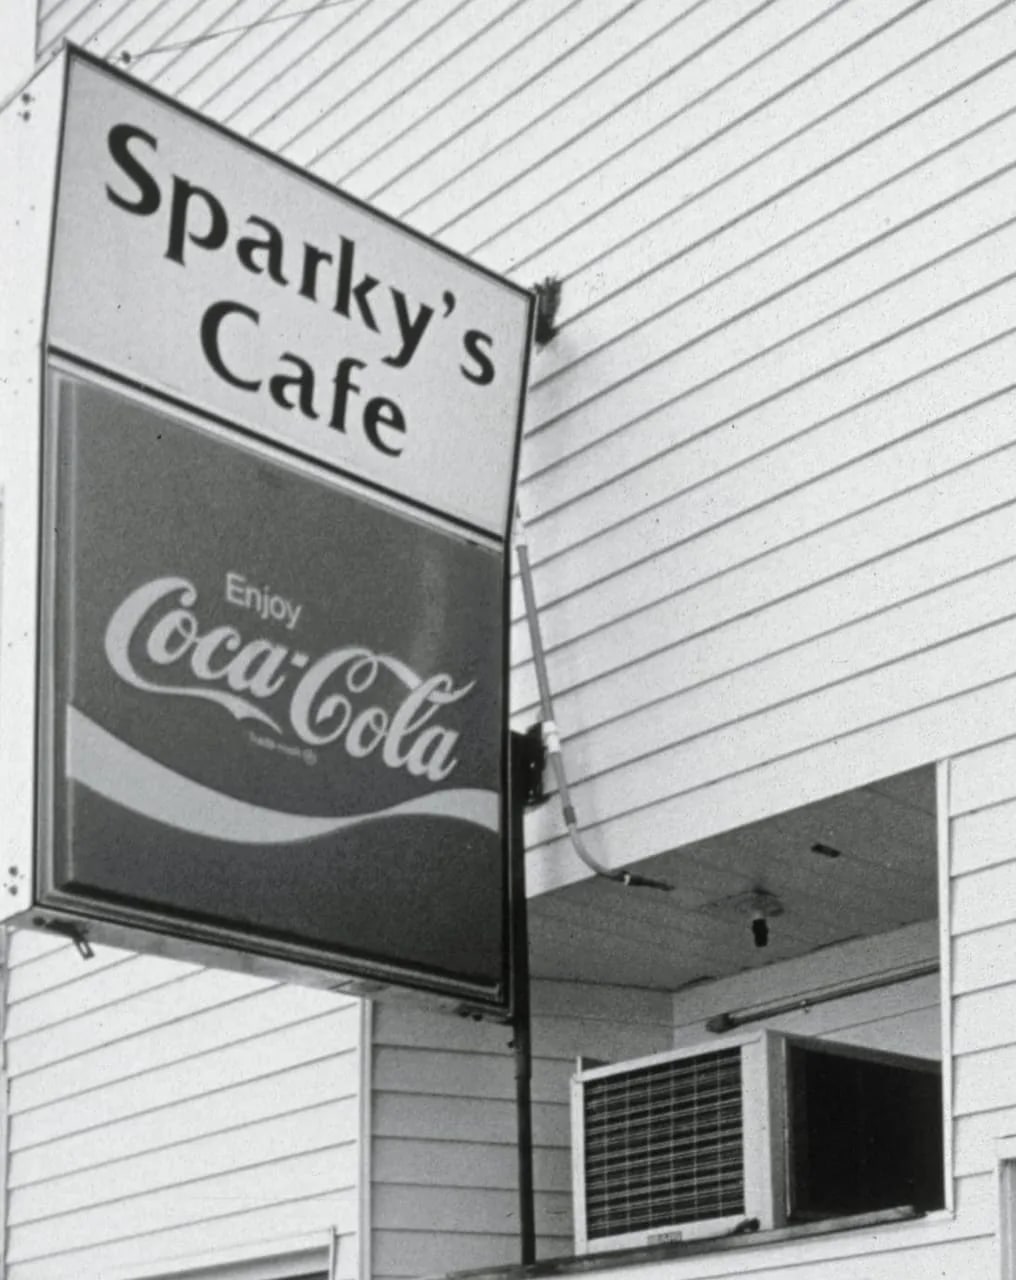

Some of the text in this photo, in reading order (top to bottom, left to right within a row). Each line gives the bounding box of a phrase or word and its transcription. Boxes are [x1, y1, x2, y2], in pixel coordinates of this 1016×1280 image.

[105, 123, 496, 386] Sparky's
[199, 300, 407, 457] Cafe
[225, 572, 303, 629] Enjoy
